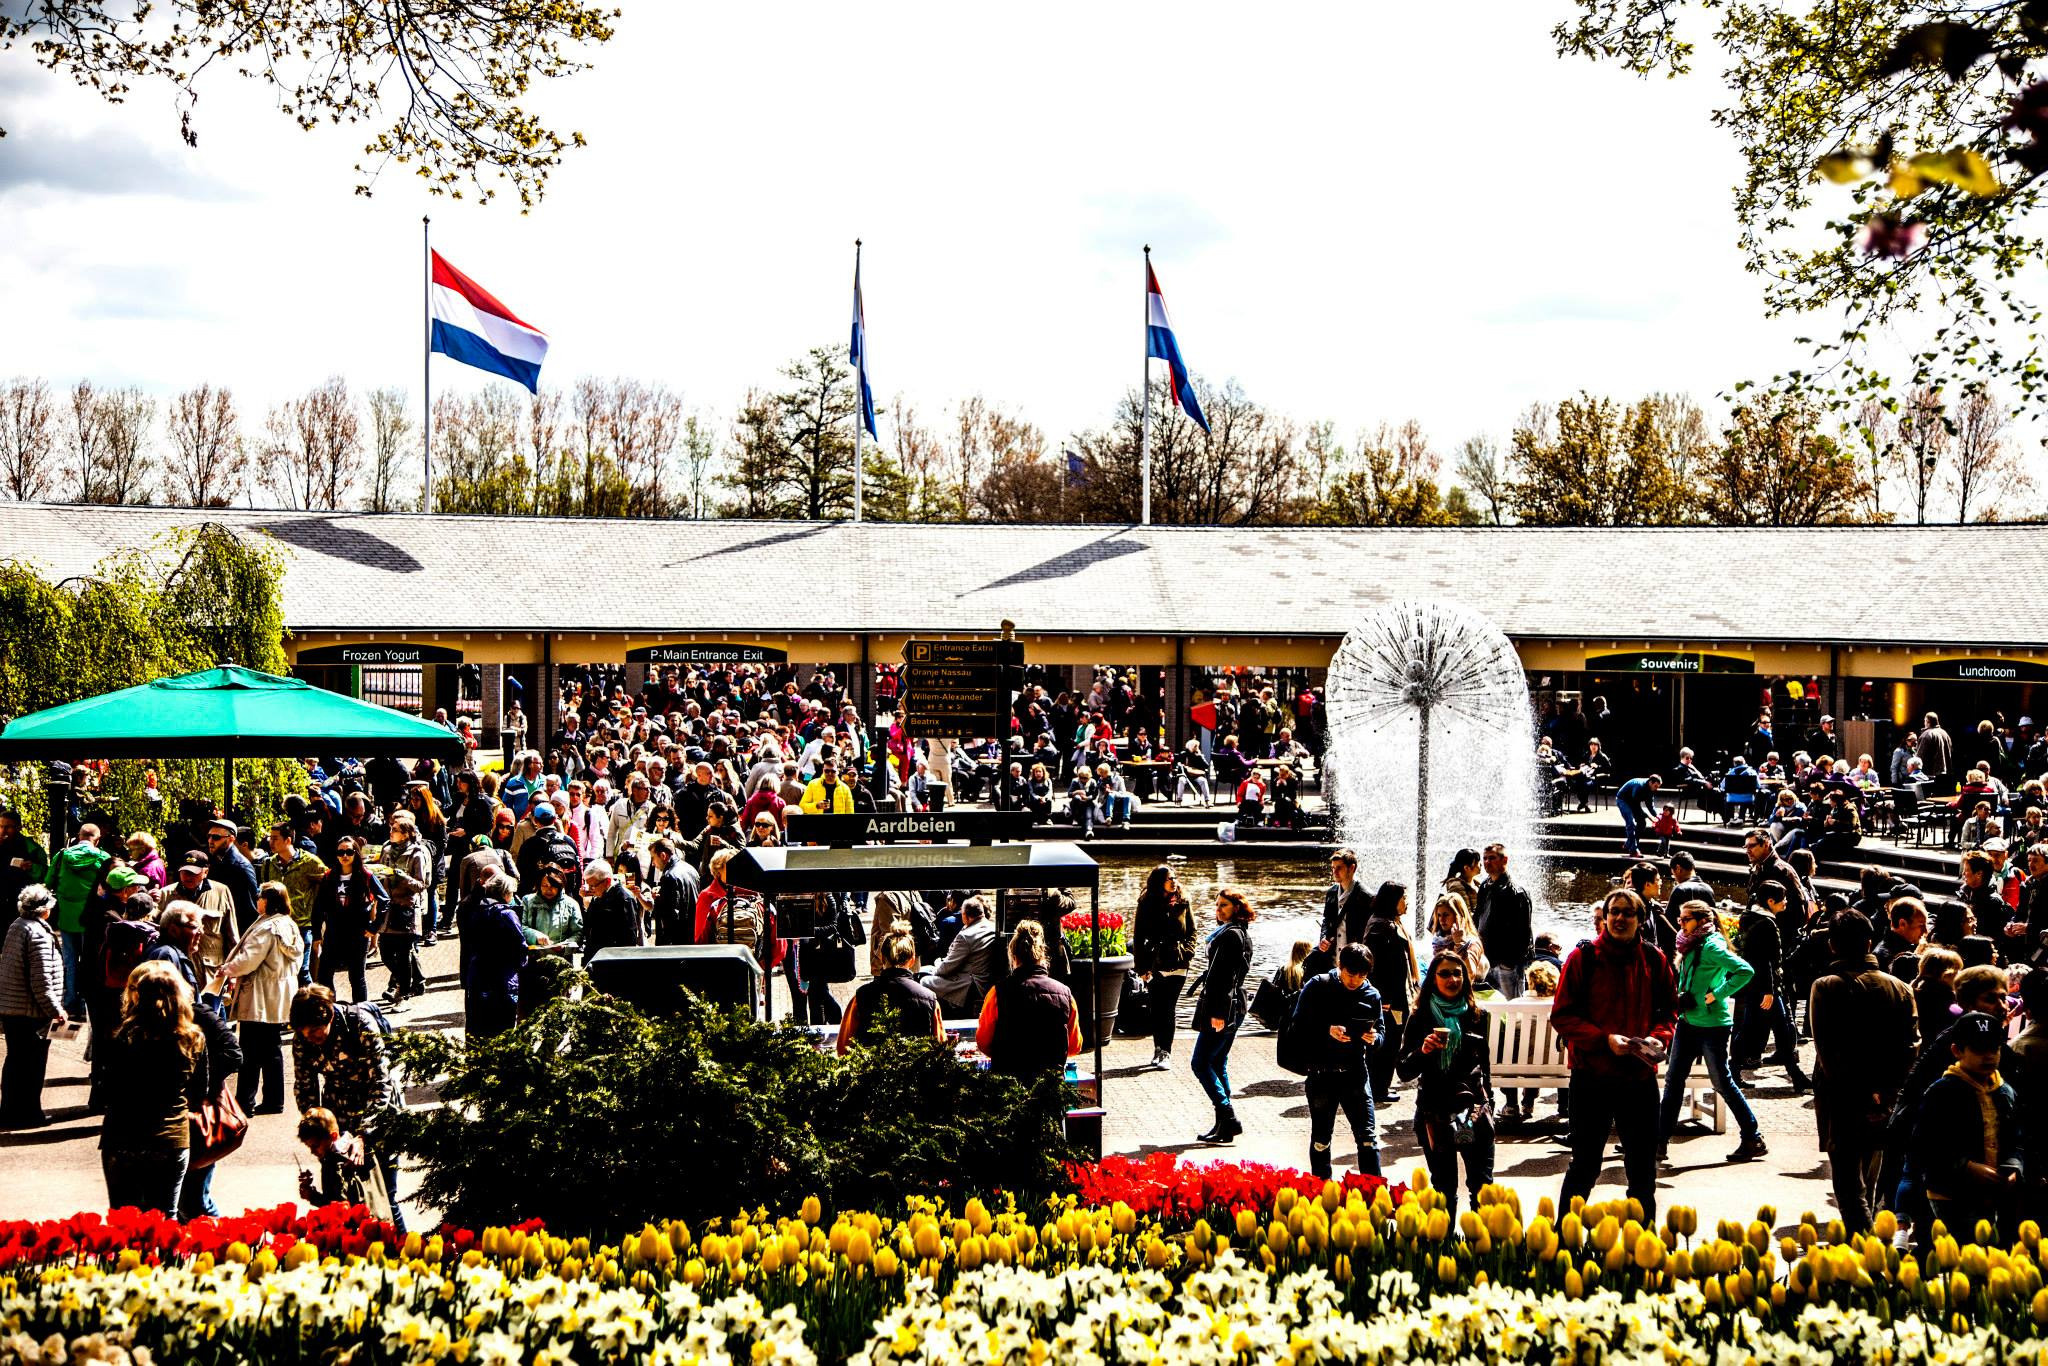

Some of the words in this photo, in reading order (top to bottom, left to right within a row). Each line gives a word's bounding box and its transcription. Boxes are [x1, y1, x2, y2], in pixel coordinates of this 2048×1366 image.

[916, 646, 927, 659] P
[933, 644, 970, 652] Entrance
[343, 650, 381, 661] Frozen
[384, 650, 420, 663] Yogurt
[691, 650, 739, 660] Entrance
[743, 650, 764, 660] Exit
[1641, 658, 1699, 670] Souvenirs
[912, 668, 939, 677] Oranje
[941, 668, 972, 676] Nassau
[1959, 665, 2016, 678] Lunchroom
[912, 693, 983, 701] Willem-Alexander
[911, 717, 940, 725] Beatrix
[866, 817, 955, 833] Aardbeien
[1976, 1020, 1989, 1032] W
